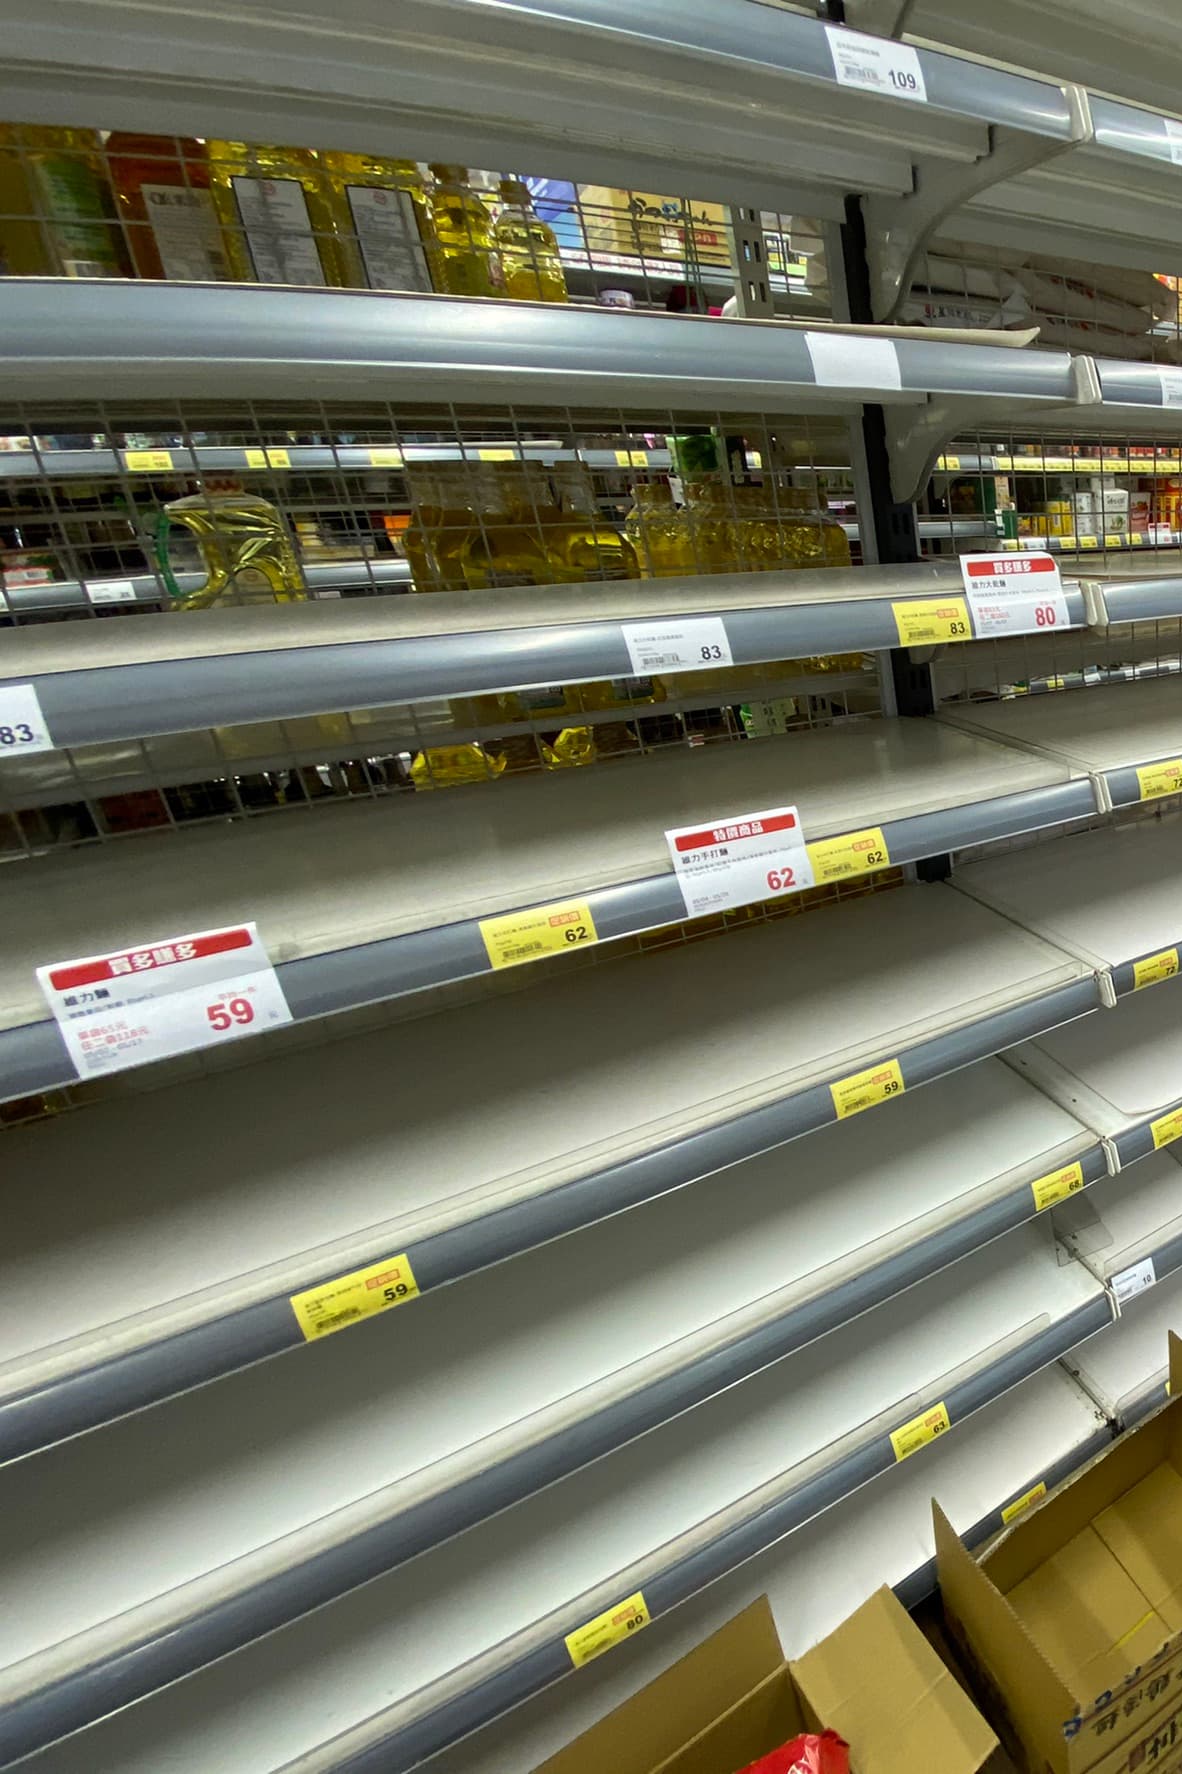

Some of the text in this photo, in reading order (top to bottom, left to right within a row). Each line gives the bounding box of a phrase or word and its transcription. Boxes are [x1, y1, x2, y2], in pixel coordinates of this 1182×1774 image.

[888, 68, 917, 90] 109
[1034, 606, 1057, 627] 80
[949, 622, 966, 635] 83
[700, 645, 722, 660] 83
[0, 724, 34, 744] 83
[867, 850, 884, 865] 62
[766, 866, 797, 890] 62
[565, 926, 588, 942] 62
[1166, 966, 1176, 976] 72
[206, 998, 255, 1032] 59
[884, 1081, 899, 1095] 59
[383, 1283, 408, 1301] 59
[932, 1421, 945, 1434] 63
[626, 1615, 644, 1631] 80
